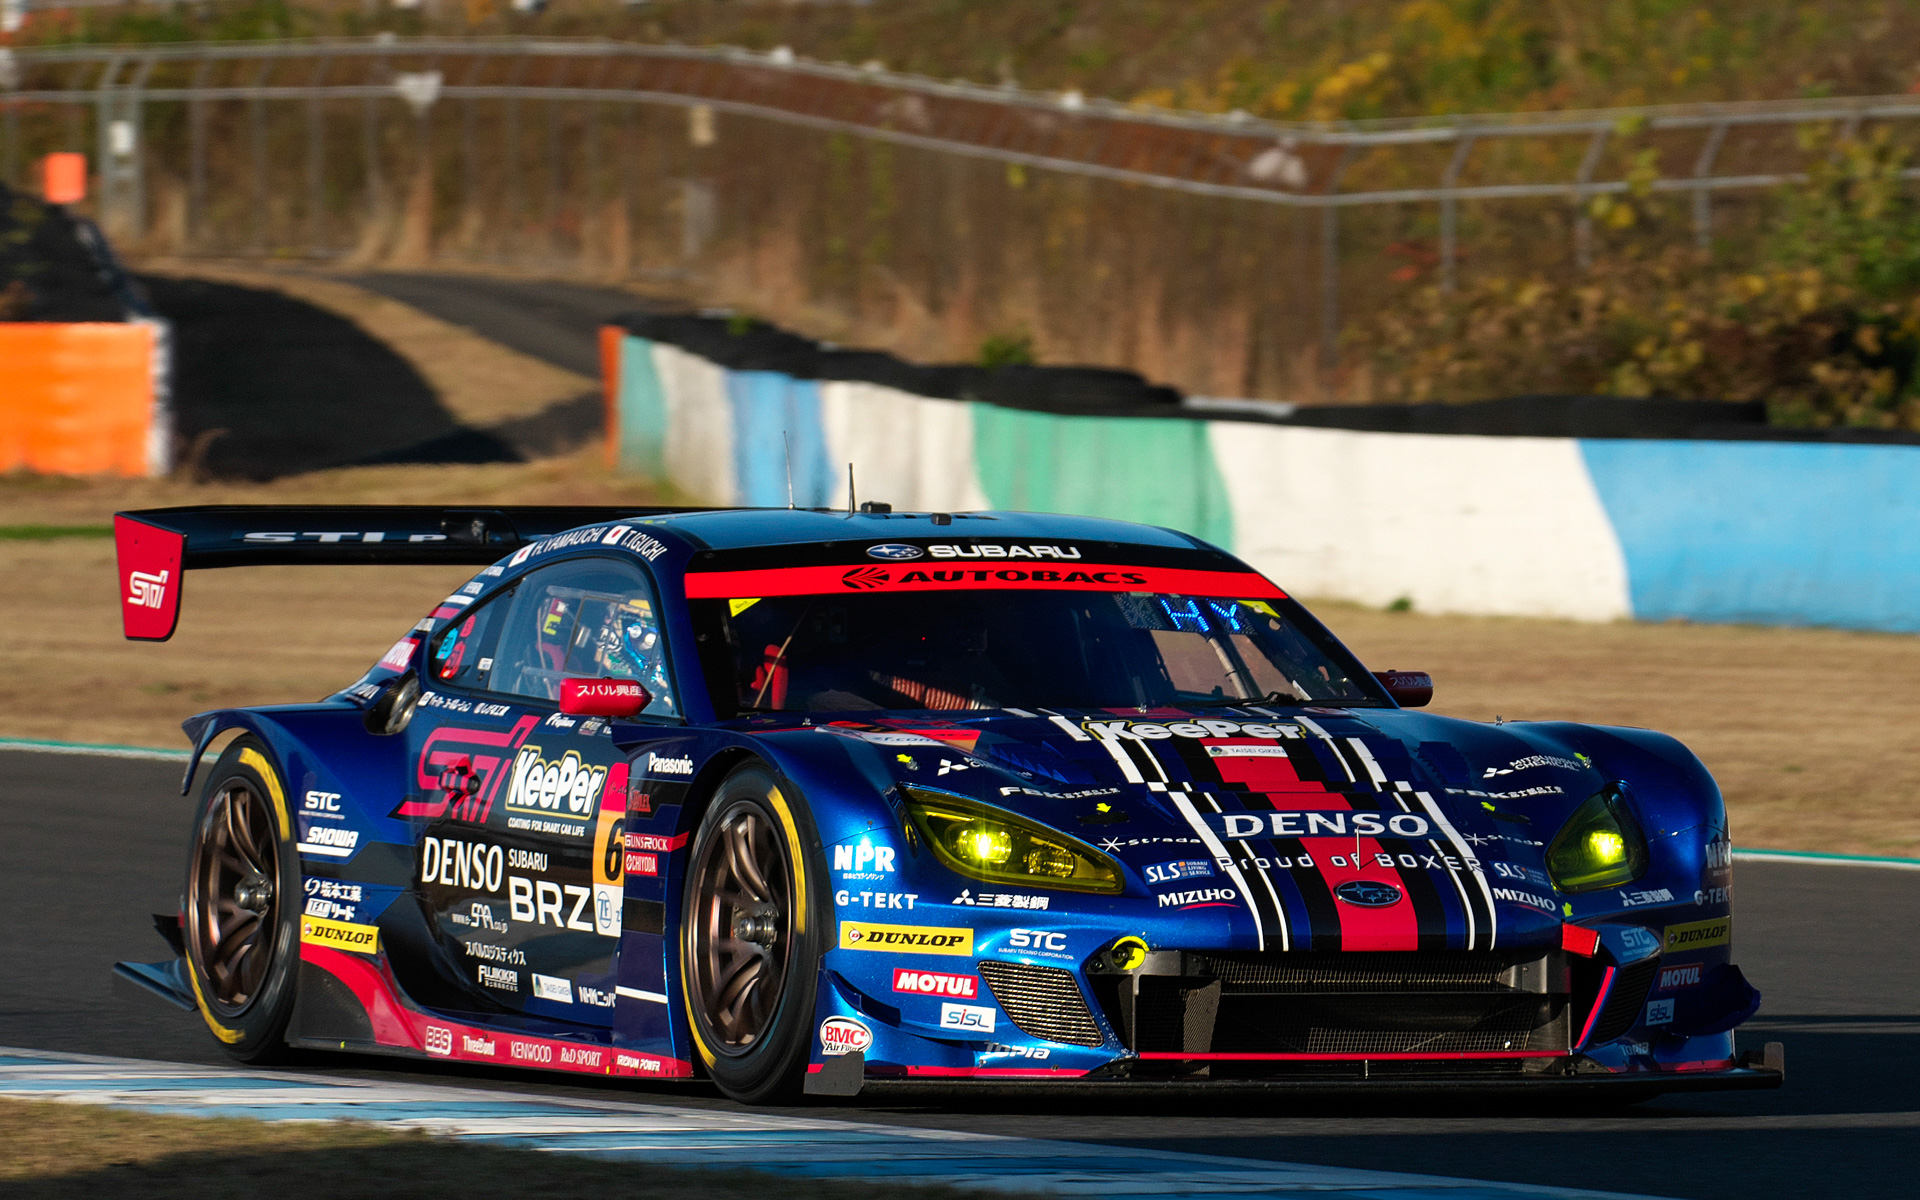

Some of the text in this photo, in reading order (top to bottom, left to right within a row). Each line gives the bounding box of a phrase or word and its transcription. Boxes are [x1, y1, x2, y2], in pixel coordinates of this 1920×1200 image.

[243, 531, 386, 543] STI
[531, 526, 609, 557] H.YAMAUCHI
[620, 529, 668, 562] T.IGUCHI
[927, 544, 1082, 560] SUBARU
[897, 570, 1148, 585] AUTOBACS
[576, 683, 644, 697] スバル興産
[1086, 719, 1303, 741] KeePer
[648, 751, 694, 775] Panasonic
[507, 747, 607, 816] KeePer
[305, 790, 341, 812] STC
[560, 823, 571, 834] CAR
[572, 825, 585, 837] LIFE
[1222, 813, 1429, 838] DENSO
[306, 826, 359, 849] SHOWA
[625, 834, 668, 851] GUNSROCK
[421, 836, 503, 892] DENSO
[508, 848, 548, 872] SUBARU
[632, 855, 656, 873] CHIYODA
[834, 844, 896, 873] NPR
[1213, 853, 1315, 872] Proud
[1374, 853, 1484, 872] BOXER
[1146, 863, 1180, 883] SLS
[1494, 862, 1526, 880] SLS
[509, 875, 594, 932] BRZ
[835, 890, 919, 910] G-TEKT
[1158, 888, 1236, 908] MIZUHO
[1493, 887, 1556, 911] MIZUHO
[313, 925, 374, 945] DUNLOP
[865, 931, 965, 948] DUNLOP
[1010, 928, 1067, 951] STC
[1621, 926, 1650, 948] STC
[1678, 924, 1727, 944] DUNLOP
[896, 972, 974, 996] MOTUL
[1660, 966, 1700, 988] MOTUL
[425, 1026, 453, 1056] BBS
[825, 1025, 865, 1045] BMC
[511, 1041, 552, 1064] KENWOOD
[825, 1042, 840, 1051] Air
[577, 1048, 602, 1068] SPORT
